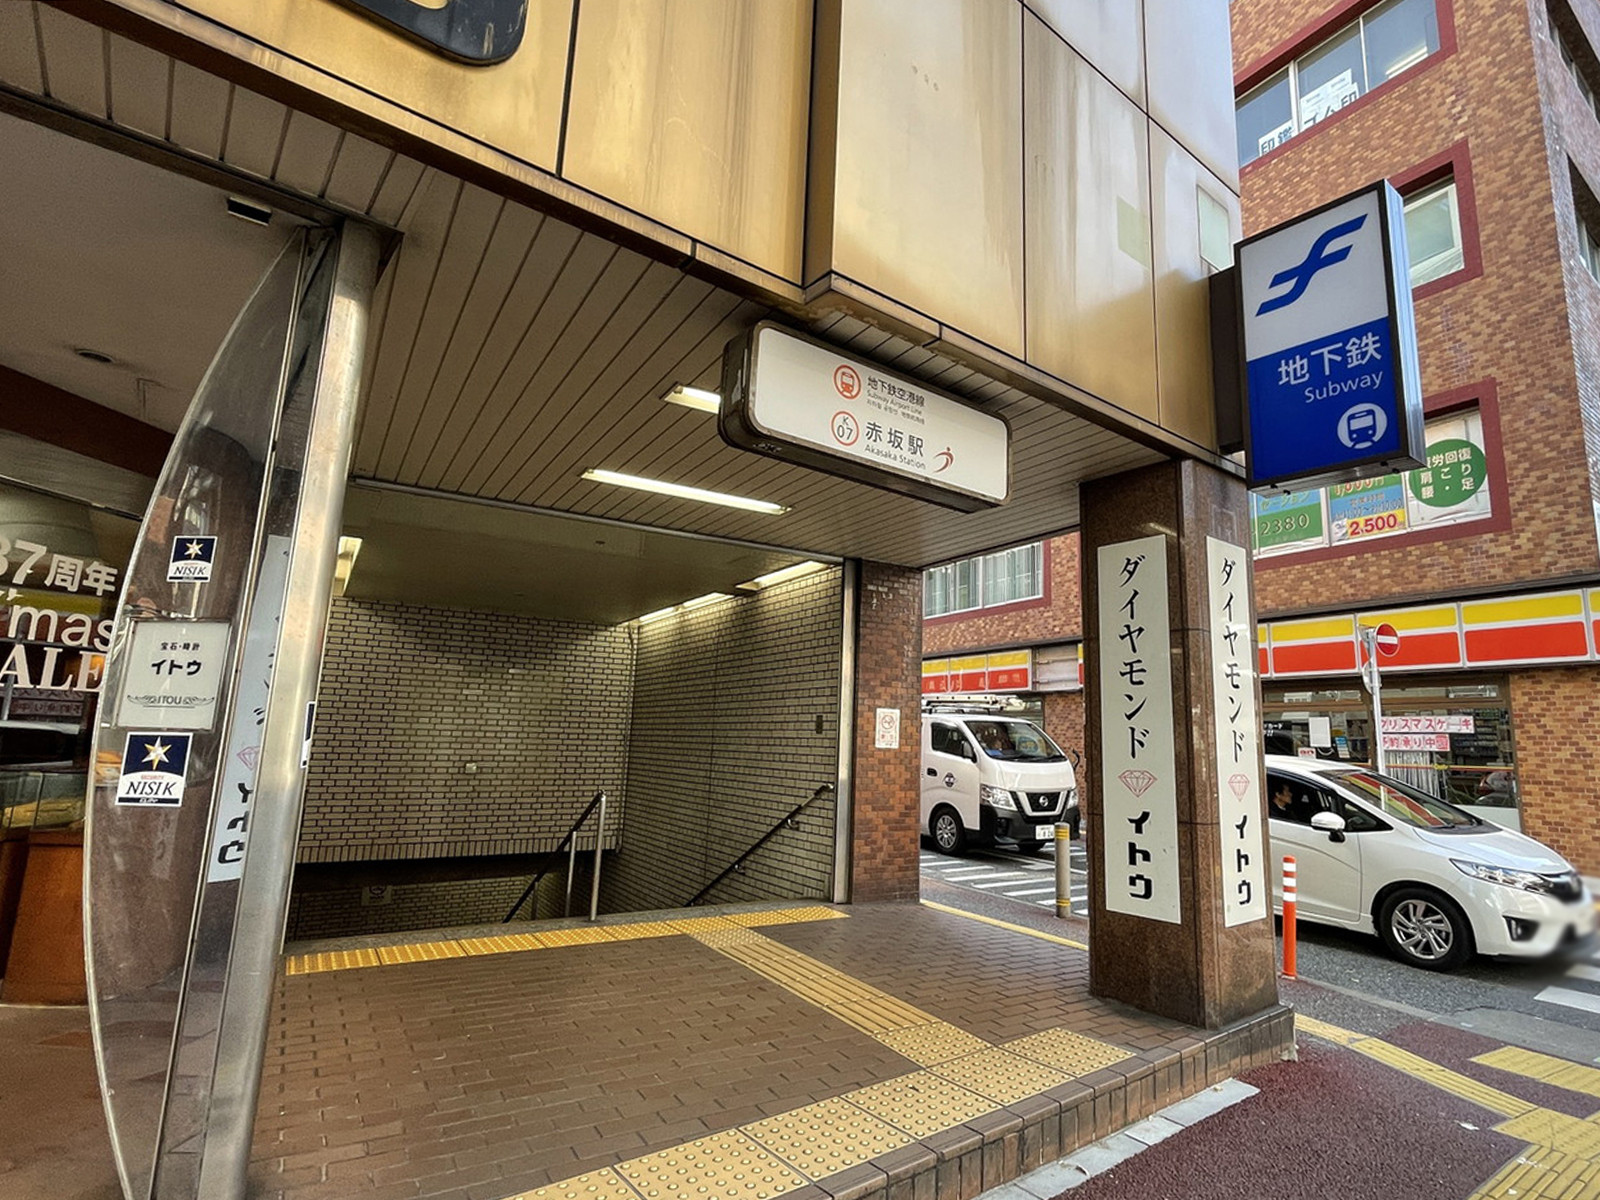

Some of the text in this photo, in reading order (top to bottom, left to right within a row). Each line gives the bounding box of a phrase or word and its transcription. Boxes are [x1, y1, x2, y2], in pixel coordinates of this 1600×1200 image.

[1277, 332, 1383, 386] 地下鉄
[867, 375, 925, 408] 地下鉄空港線
[1304, 370, 1384, 403] Subway
[836, 424, 853, 441] 07
[842, 416, 849, 426] K
[865, 421, 924, 457] 赤坂駅
[864, 443, 926, 470] Akasaka Station
[1260, 513, 1311, 536] 2380
[172, 565, 207, 576] NISIK
[151, 659, 202, 676] イトウ
[1119, 554, 1153, 901] ダイヤモンド イトウ
[1220, 557, 1251, 906] ダイヤモンド イトウ
[125, 781, 177, 796] NISIK
